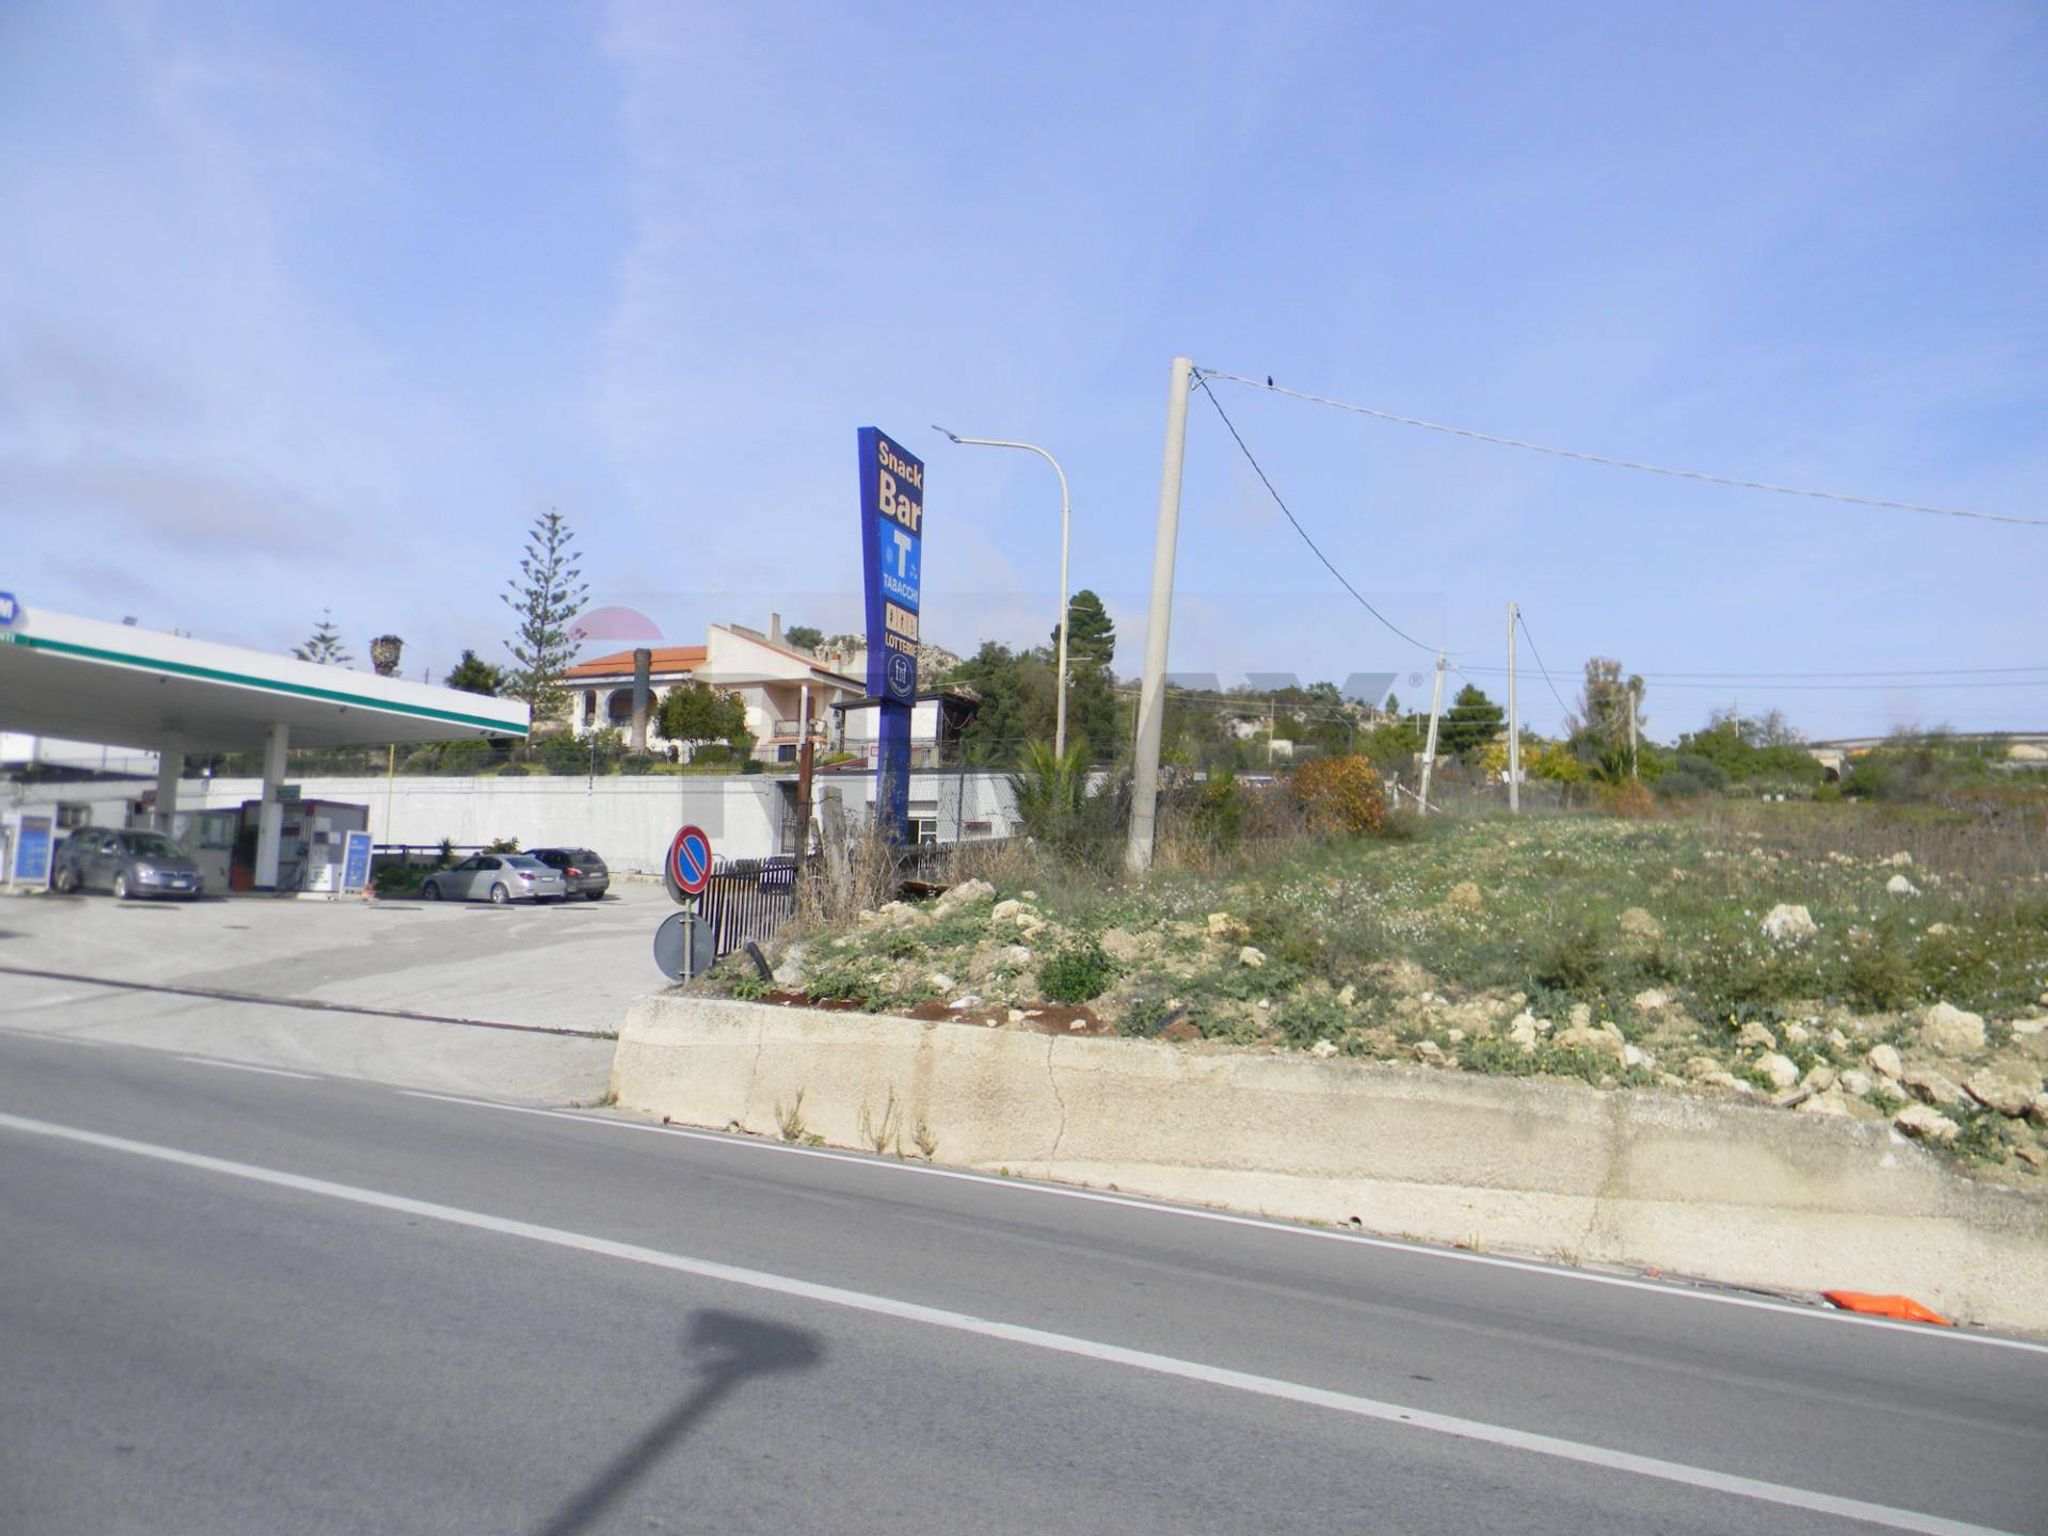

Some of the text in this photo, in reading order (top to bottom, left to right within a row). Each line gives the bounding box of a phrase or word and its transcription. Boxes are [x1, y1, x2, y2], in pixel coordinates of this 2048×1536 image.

[879, 440, 922, 490] Snack
[879, 468, 922, 532] Bar
[894, 529, 912, 578] T
[883, 572, 918, 603] TABACCHI
